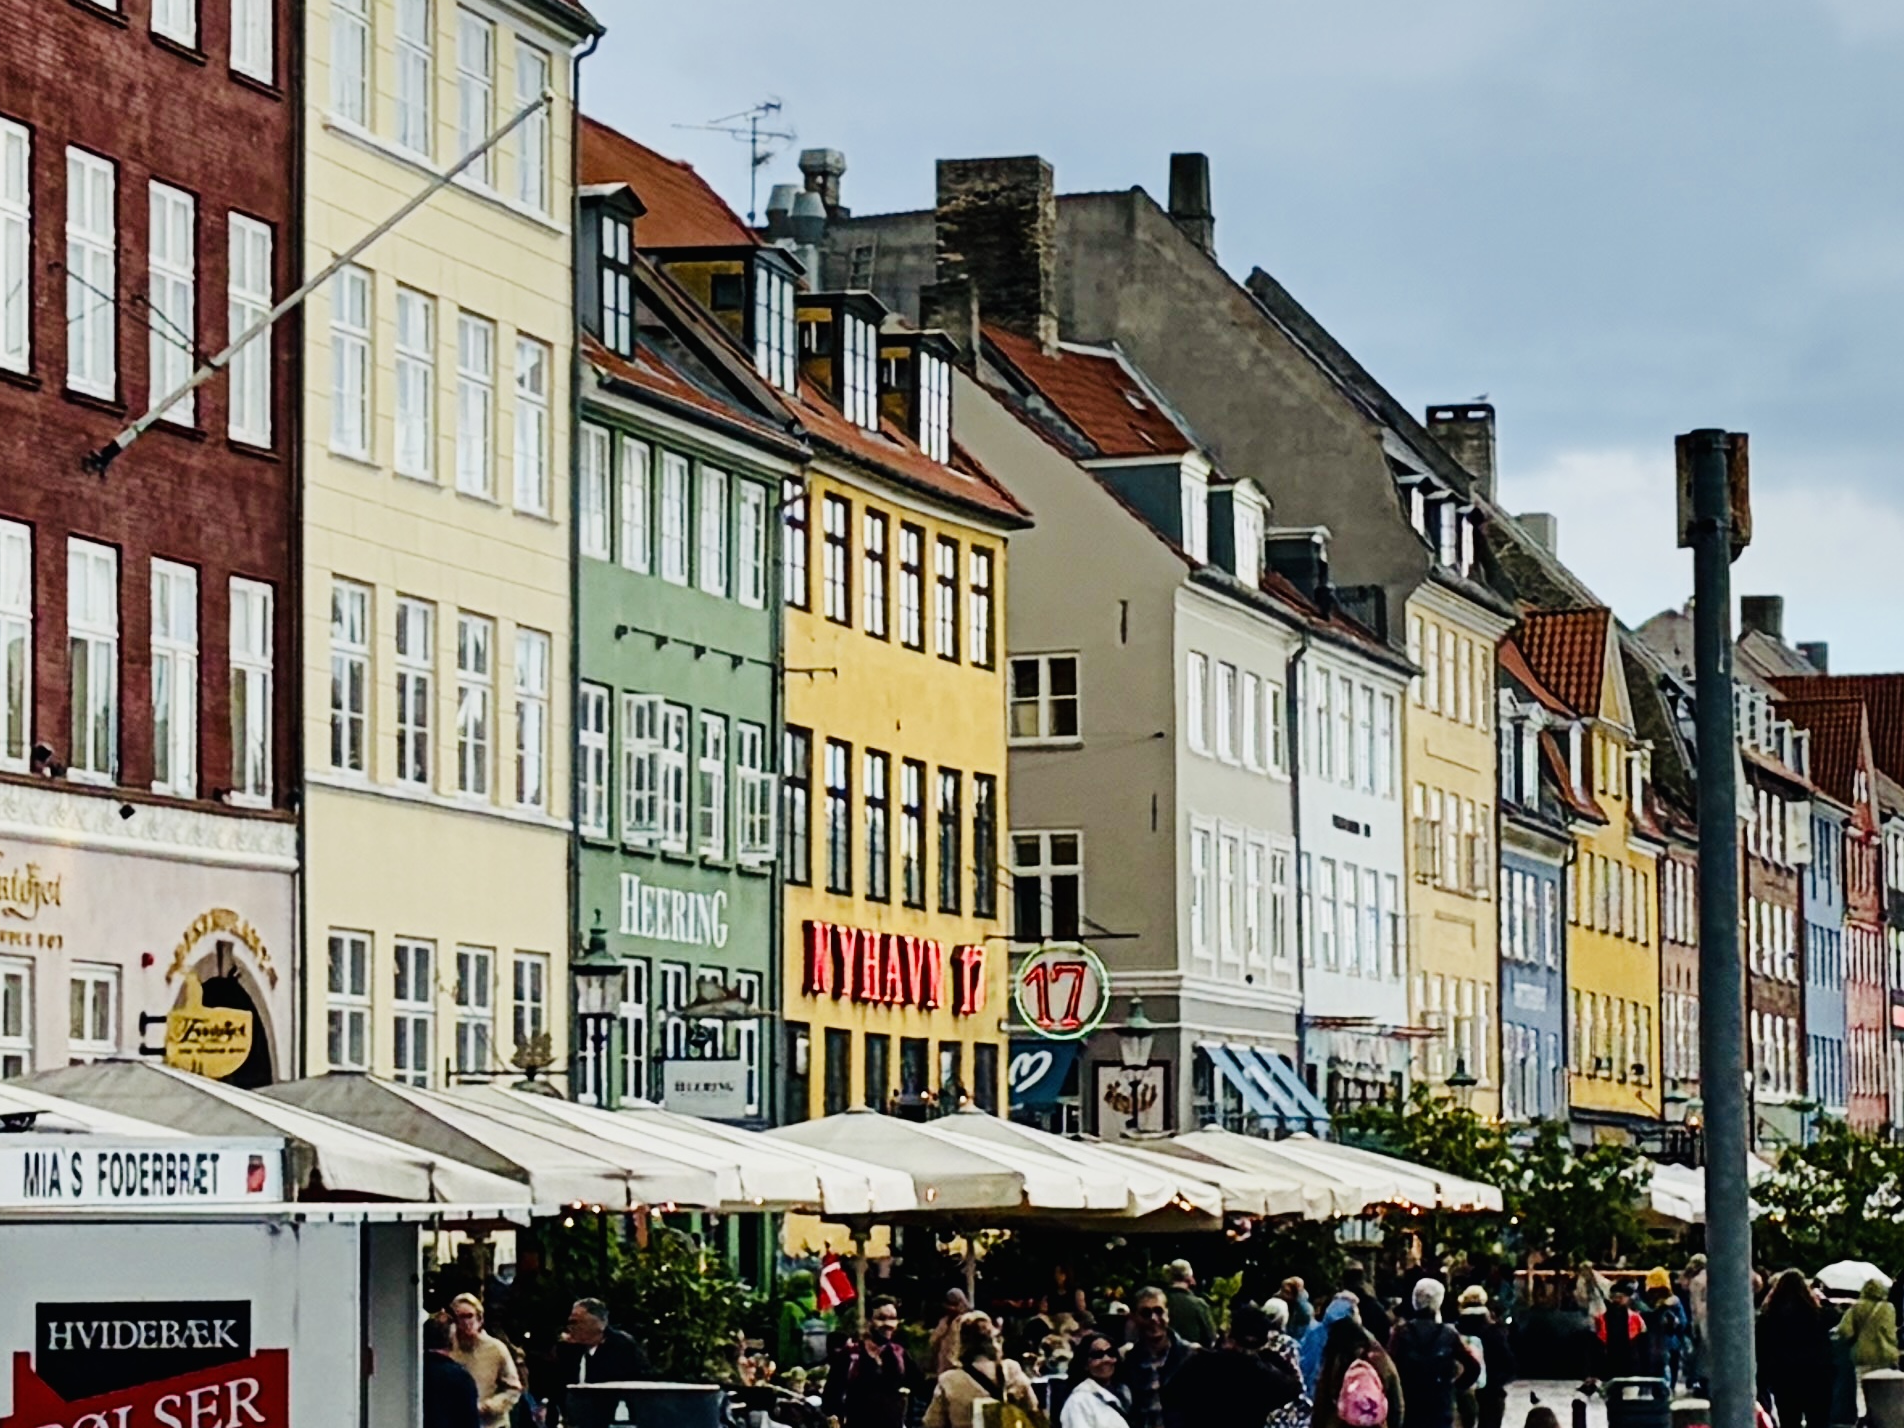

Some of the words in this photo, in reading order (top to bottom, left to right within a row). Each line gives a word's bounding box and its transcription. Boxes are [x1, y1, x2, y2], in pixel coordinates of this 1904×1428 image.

[619, 872, 729, 949] HEERING
[802, 919, 945, 1010] NYHAVN
[1023, 960, 1089, 1031] 17
[97, 1151, 220, 1198] FODERBRÆT
[48, 1319, 239, 1350] HVIDEBÆK
